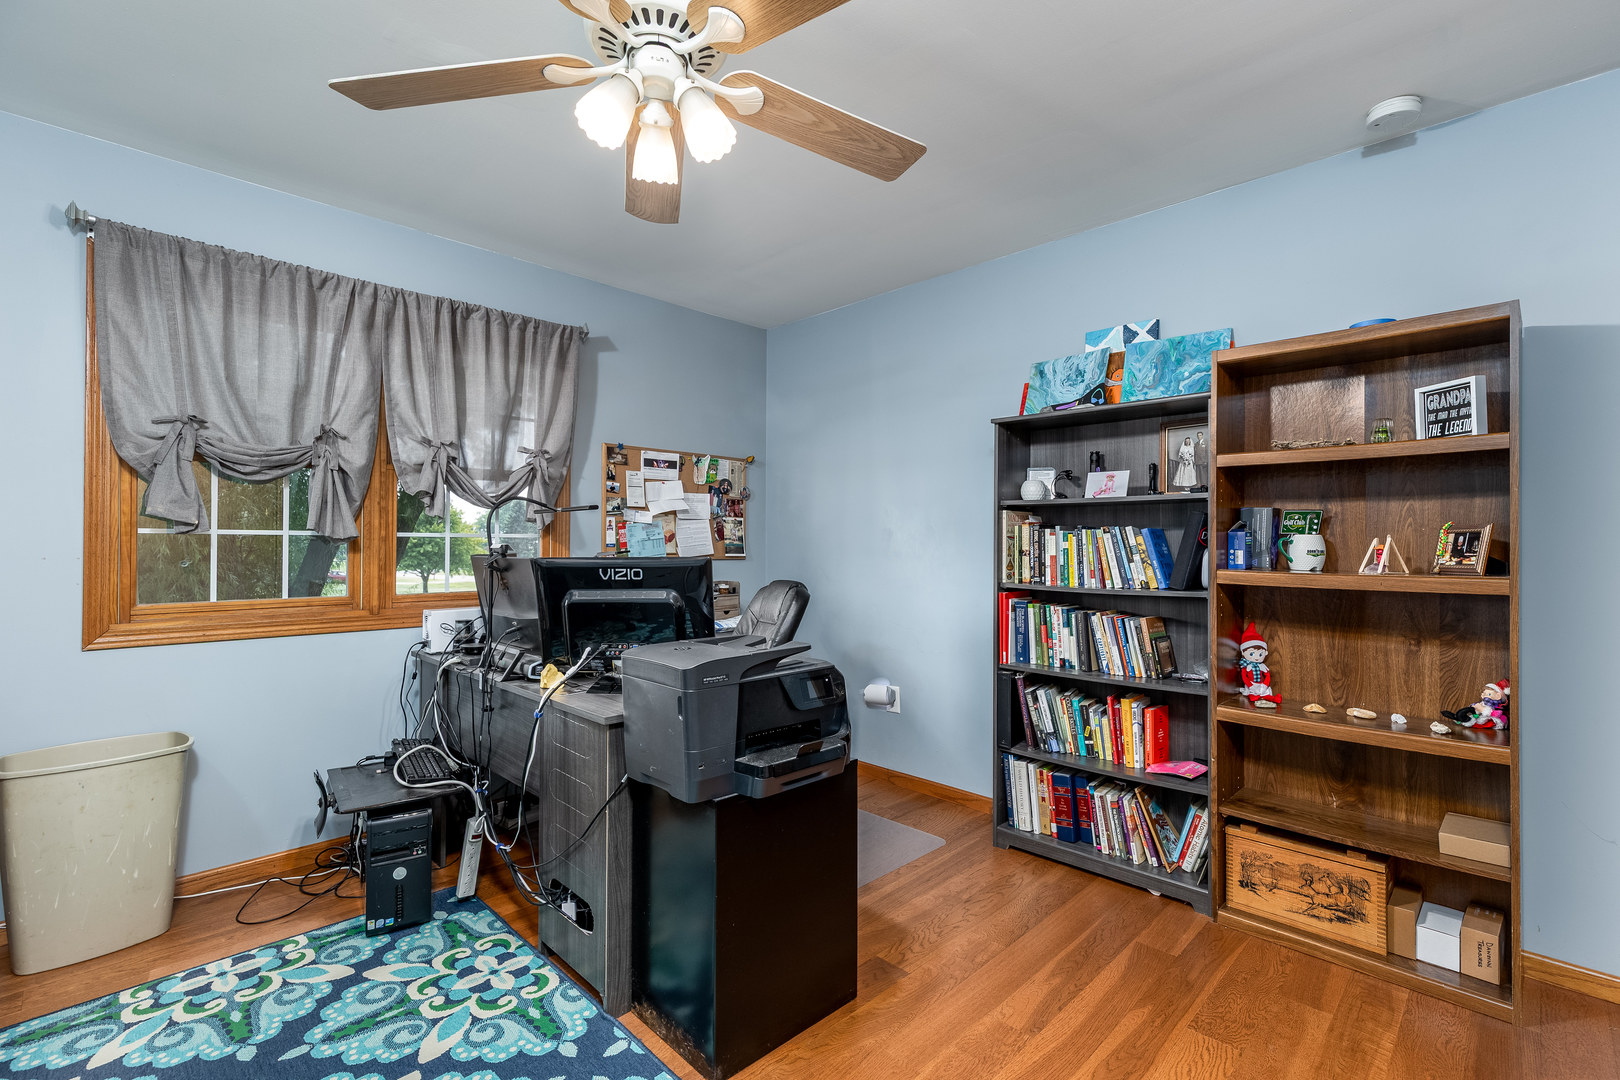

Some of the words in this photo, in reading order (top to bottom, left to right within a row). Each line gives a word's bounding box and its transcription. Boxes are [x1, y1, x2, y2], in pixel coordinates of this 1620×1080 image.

[1428, 388, 1471, 410] GRANDPA
[1428, 413, 1436, 421] THE
[1450, 409, 1458, 417] THE
[1428, 423, 1443, 437] THE
[1445, 418, 1472, 434] LEGEND
[599, 568, 643, 580] VIZIO
[1096, 637, 1108, 662] CAPTIVATE
[1065, 697, 1075, 718] COUPLE
[1068, 718, 1077, 735] SKILLS
[1195, 819, 1209, 841] Atomic
[1187, 840, 1201, 860] Habits
